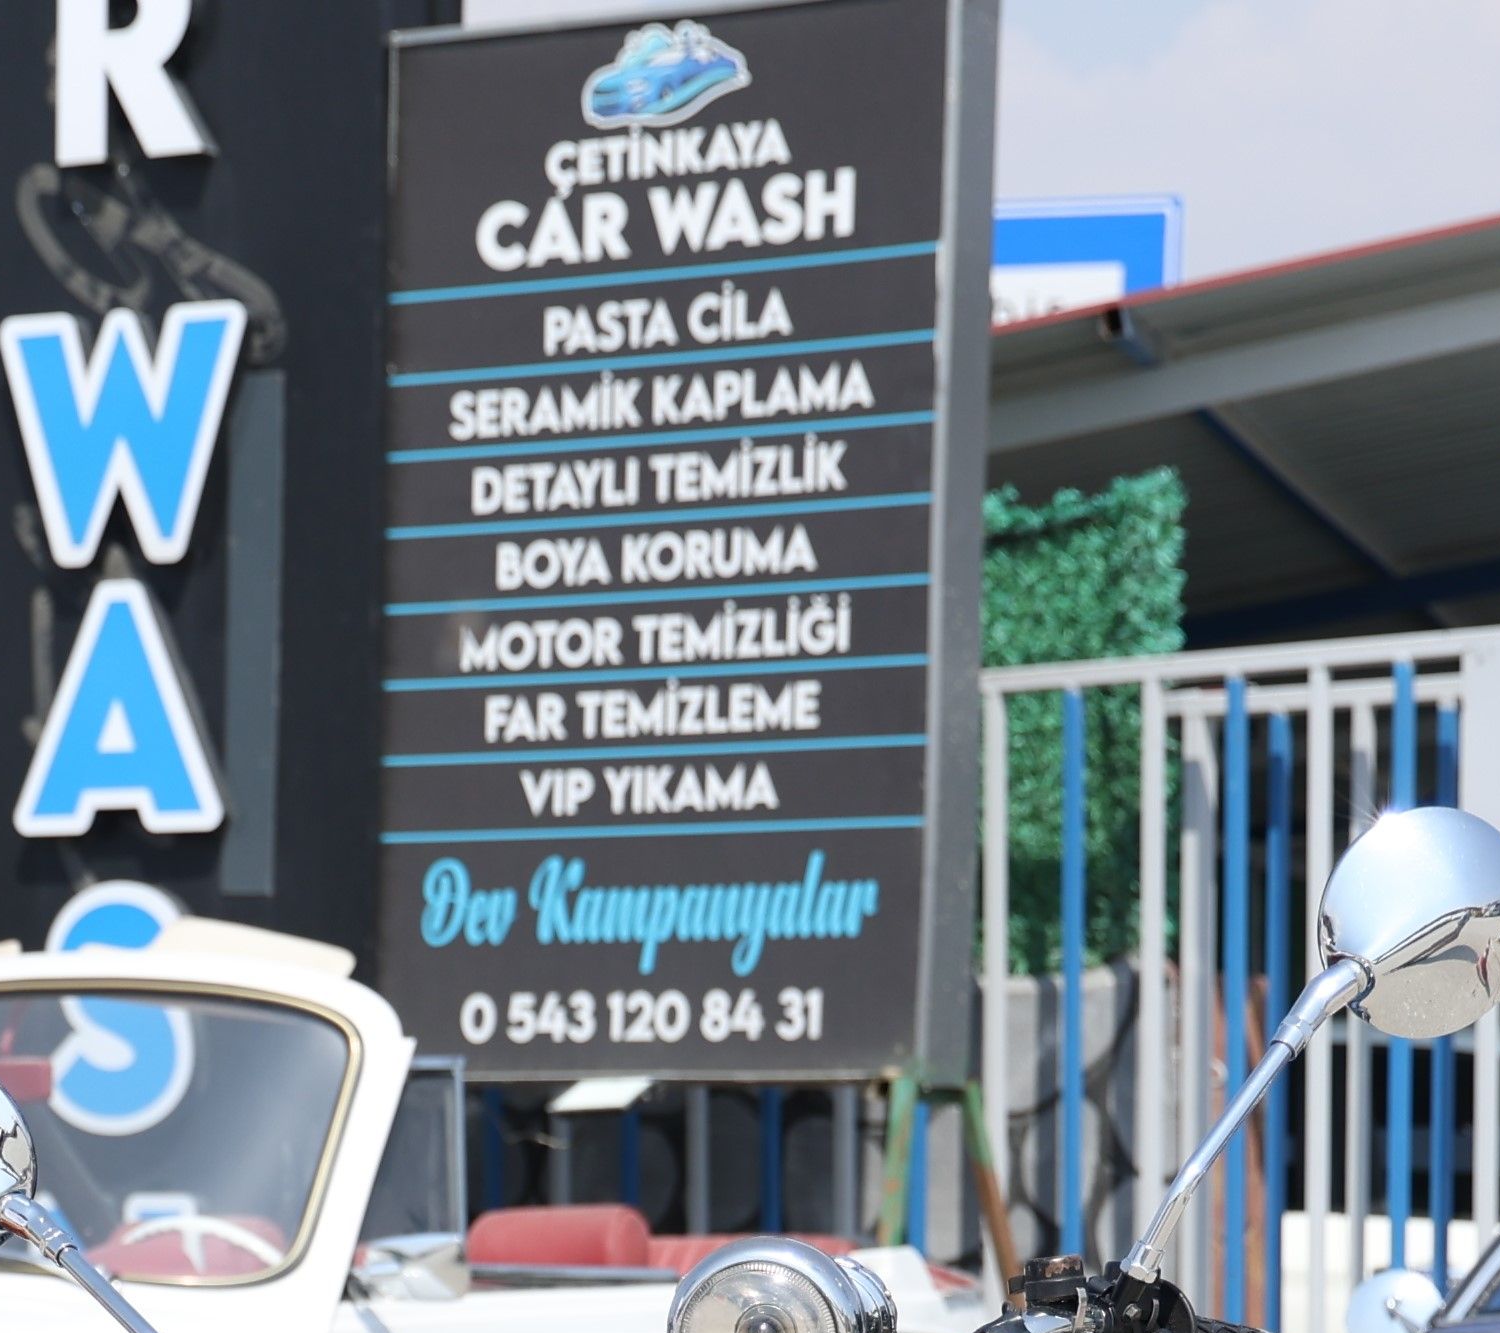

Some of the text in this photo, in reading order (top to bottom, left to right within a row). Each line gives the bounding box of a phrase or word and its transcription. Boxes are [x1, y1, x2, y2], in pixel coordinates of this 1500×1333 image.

[544, 118, 792, 199] ÇETİNKAYA
[475, 165, 858, 272] CAR WASH
[543, 280, 794, 357] PASTA CİLA
[448, 359, 875, 440] SERAMİK KAPLAMA
[470, 431, 848, 516] DETAYLI TEMİZLİK
[494, 523, 818, 591] BOYA KORUMA
[458, 591, 851, 673] MOTOR TEMİZLİĞİ
[483, 676, 822, 742] FAR TEMİZLEME
[518, 760, 780, 818] VIP YIKAMA
[420, 848, 880, 977] Dev Kampanyalar
[459, 986, 824, 1045] 0 543 120 84 31
